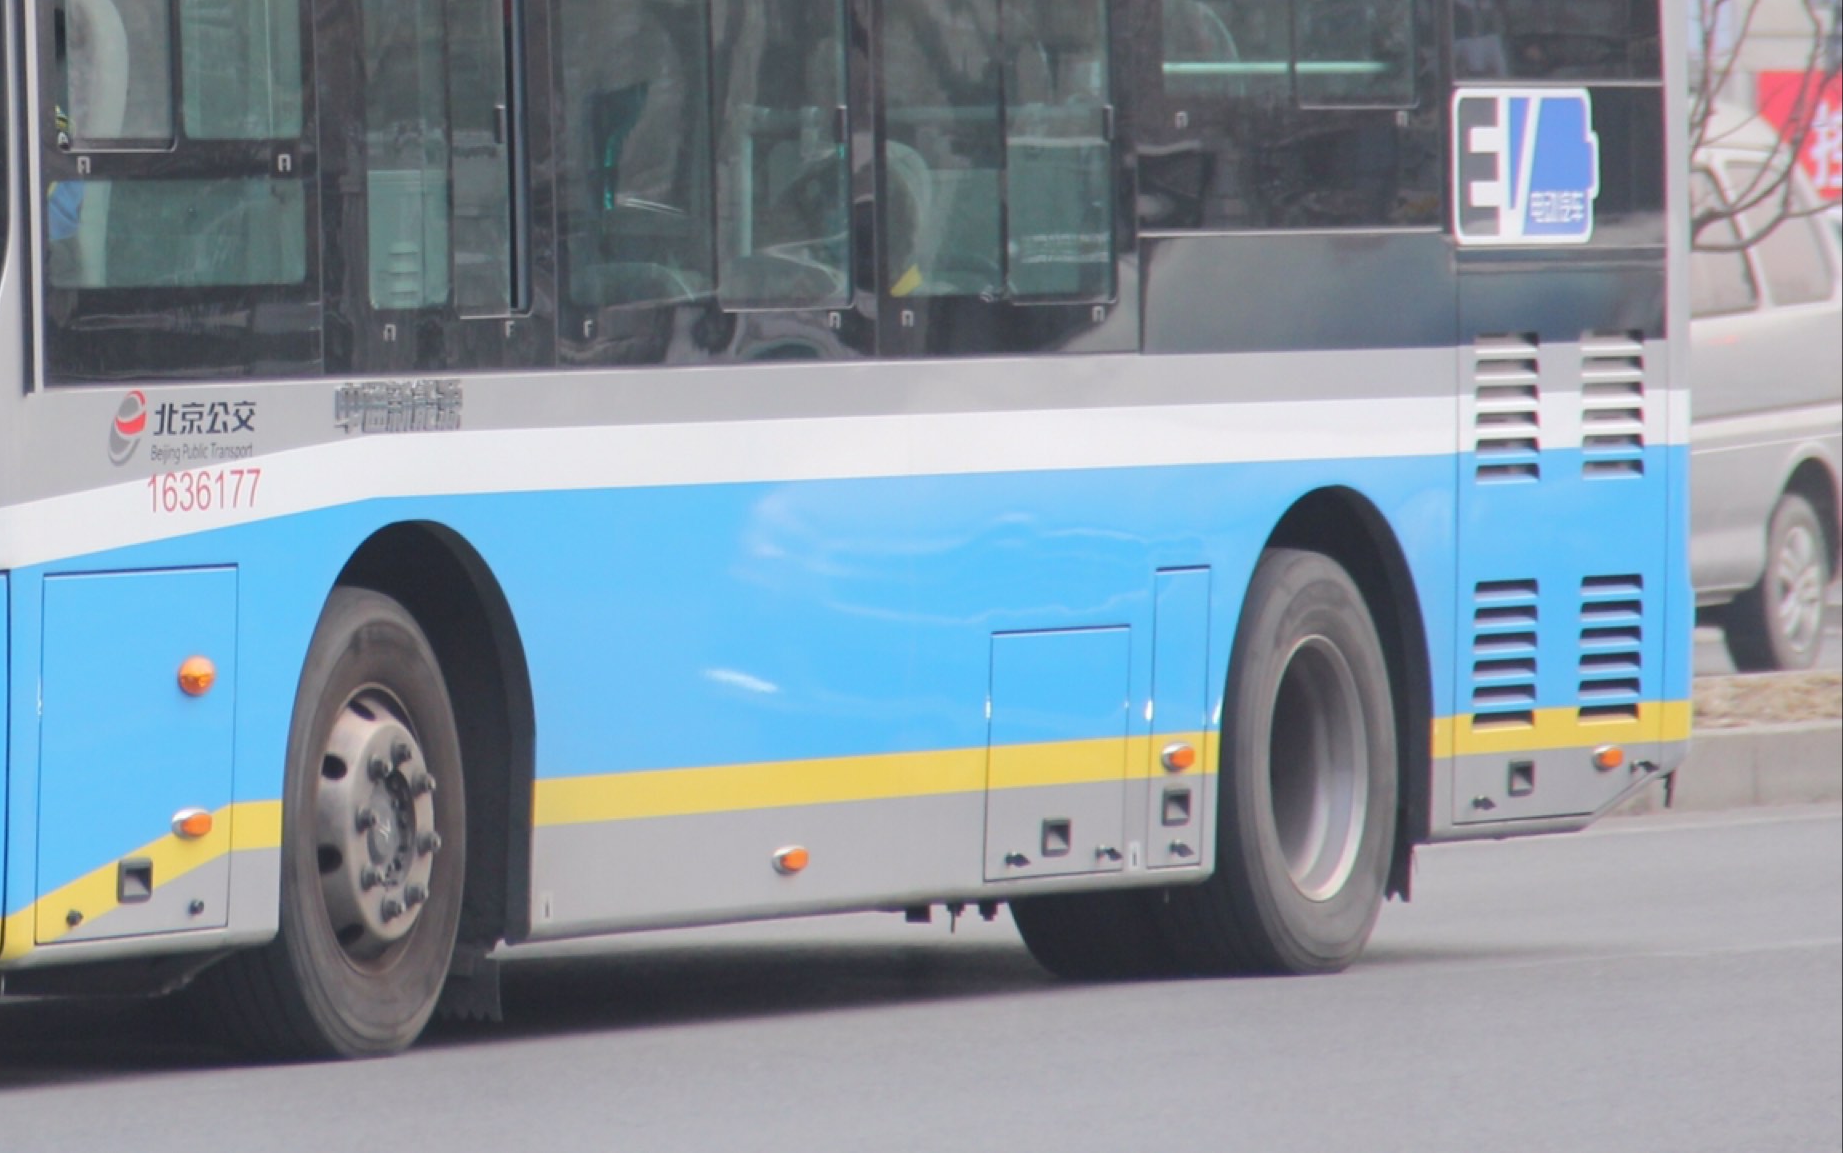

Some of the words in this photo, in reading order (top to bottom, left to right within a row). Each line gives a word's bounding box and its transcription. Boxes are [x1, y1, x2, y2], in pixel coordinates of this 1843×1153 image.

[153, 400, 257, 435] 北京公交
[150, 444, 181, 465] Beijing
[182, 443, 209, 460] Public
[211, 442, 253, 459] Transport
[147, 468, 261, 513] 1636177
